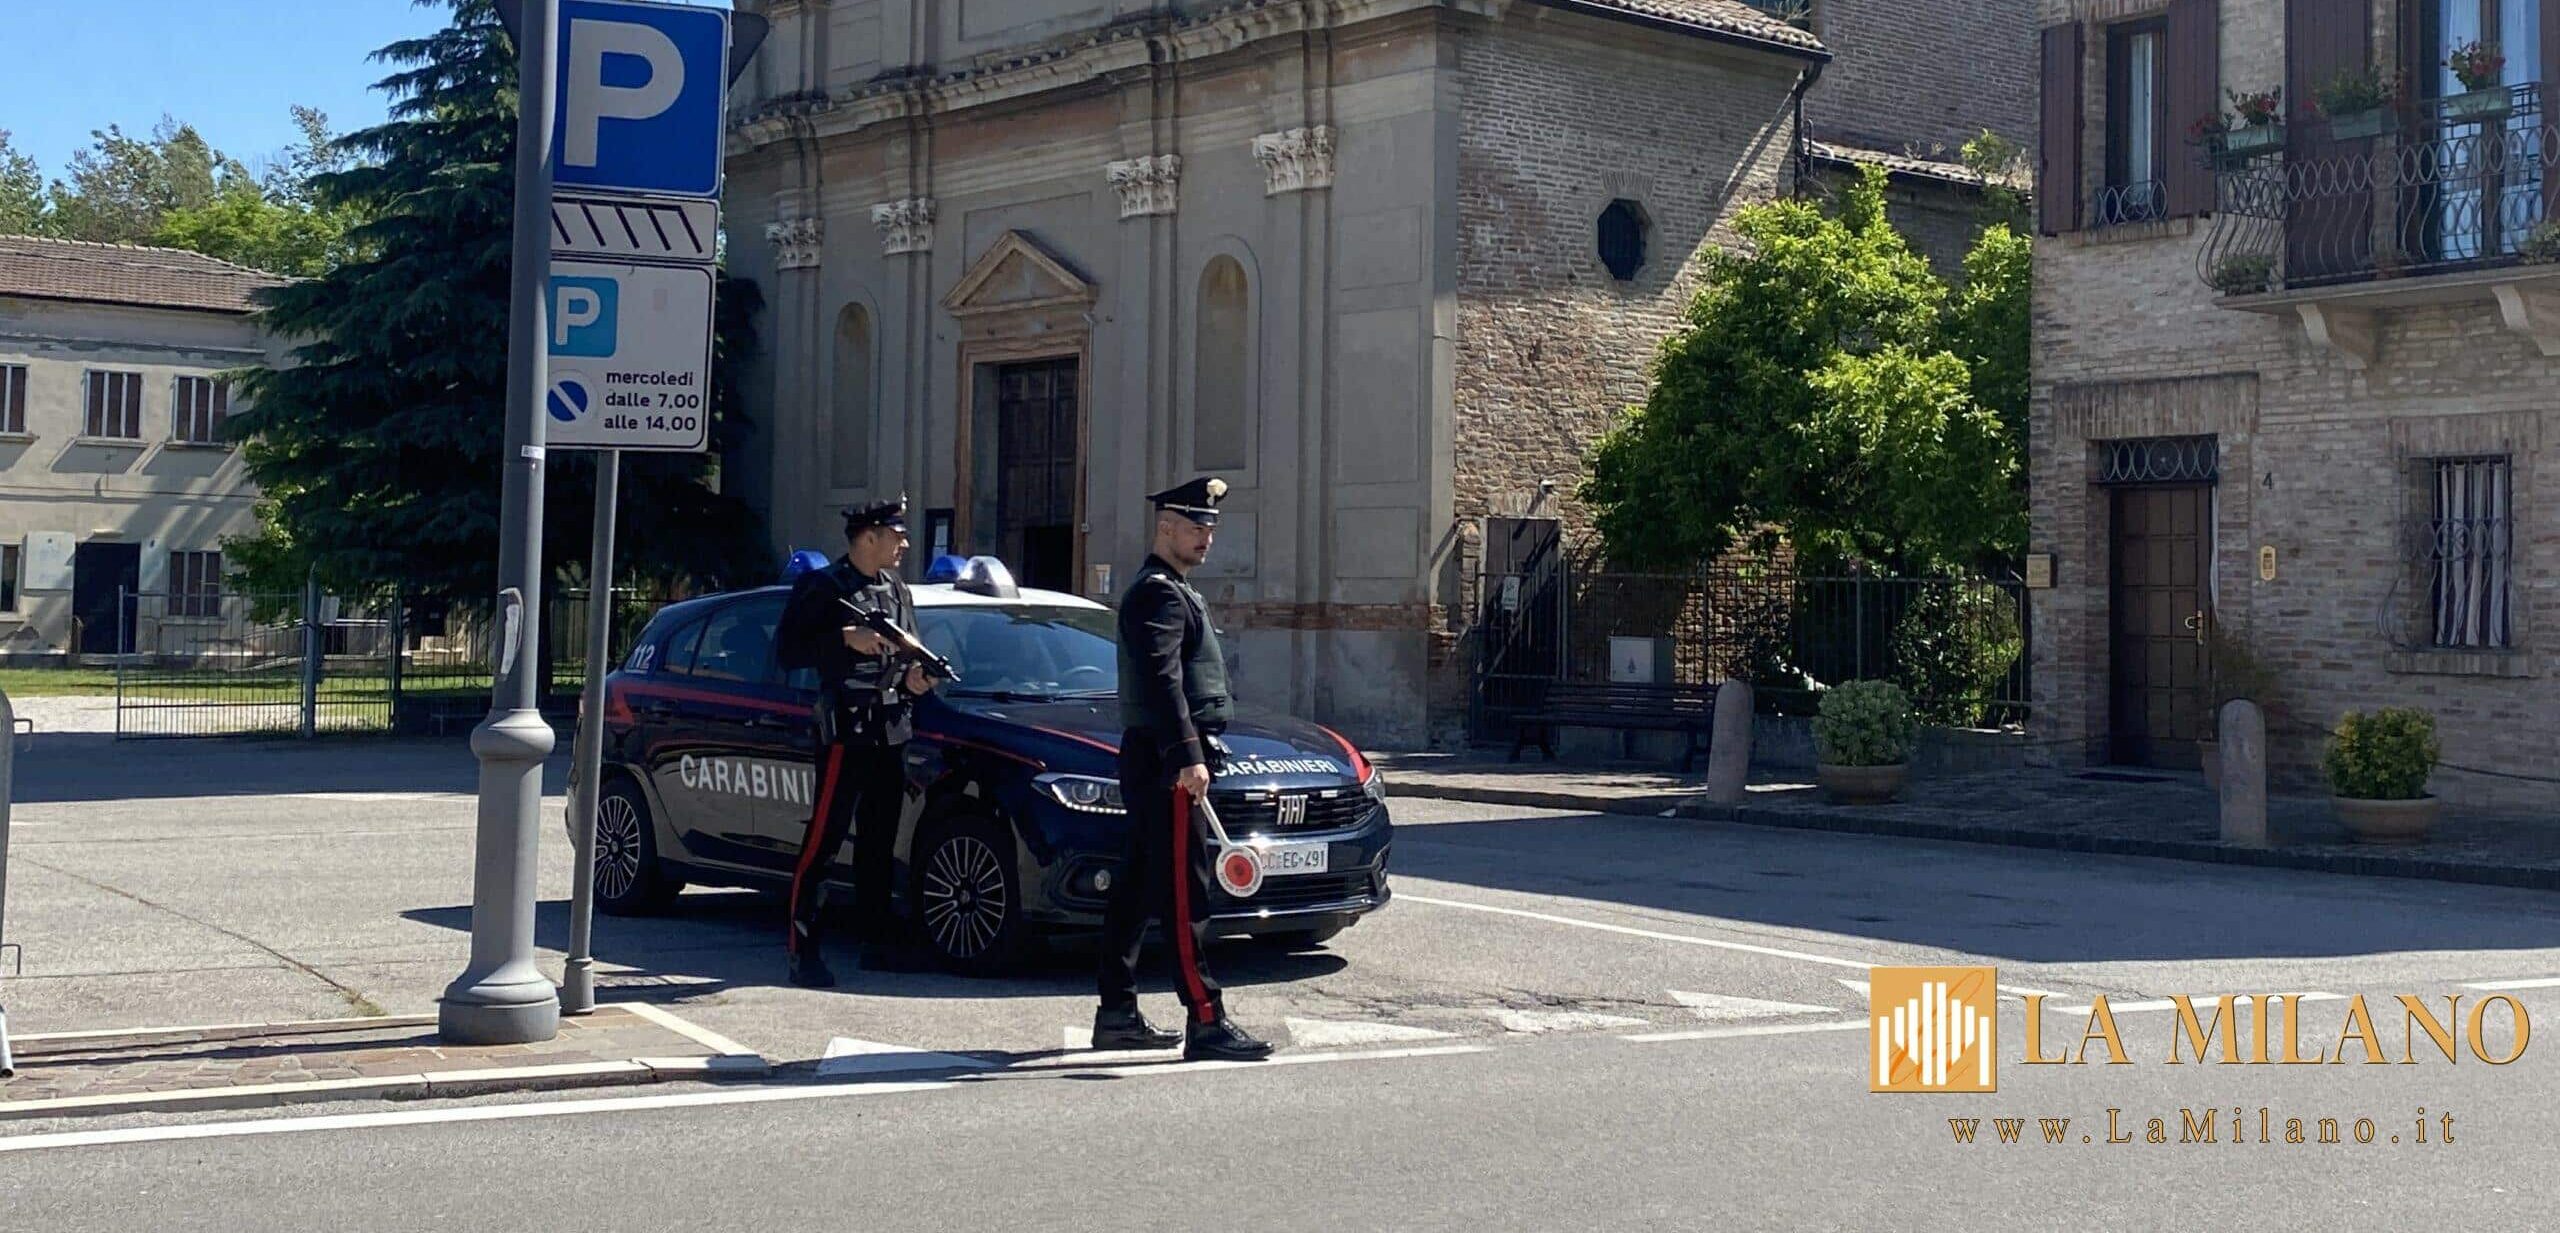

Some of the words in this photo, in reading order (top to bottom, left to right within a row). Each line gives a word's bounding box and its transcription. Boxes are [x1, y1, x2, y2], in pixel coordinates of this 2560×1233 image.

[564, 18, 685, 168] P
[555, 286, 601, 346] P
[606, 371, 694, 386] mercoledi
[605, 392, 650, 407] dalle
[658, 393, 699, 409] 7.00
[604, 414, 638, 430] alle
[646, 416, 696, 432] 14.00
[2262, 472, 2274, 490] 4
[630, 644, 656, 669] 112
[680, 754, 816, 806] CARABINI
[1276, 794, 1309, 825] FIAT
